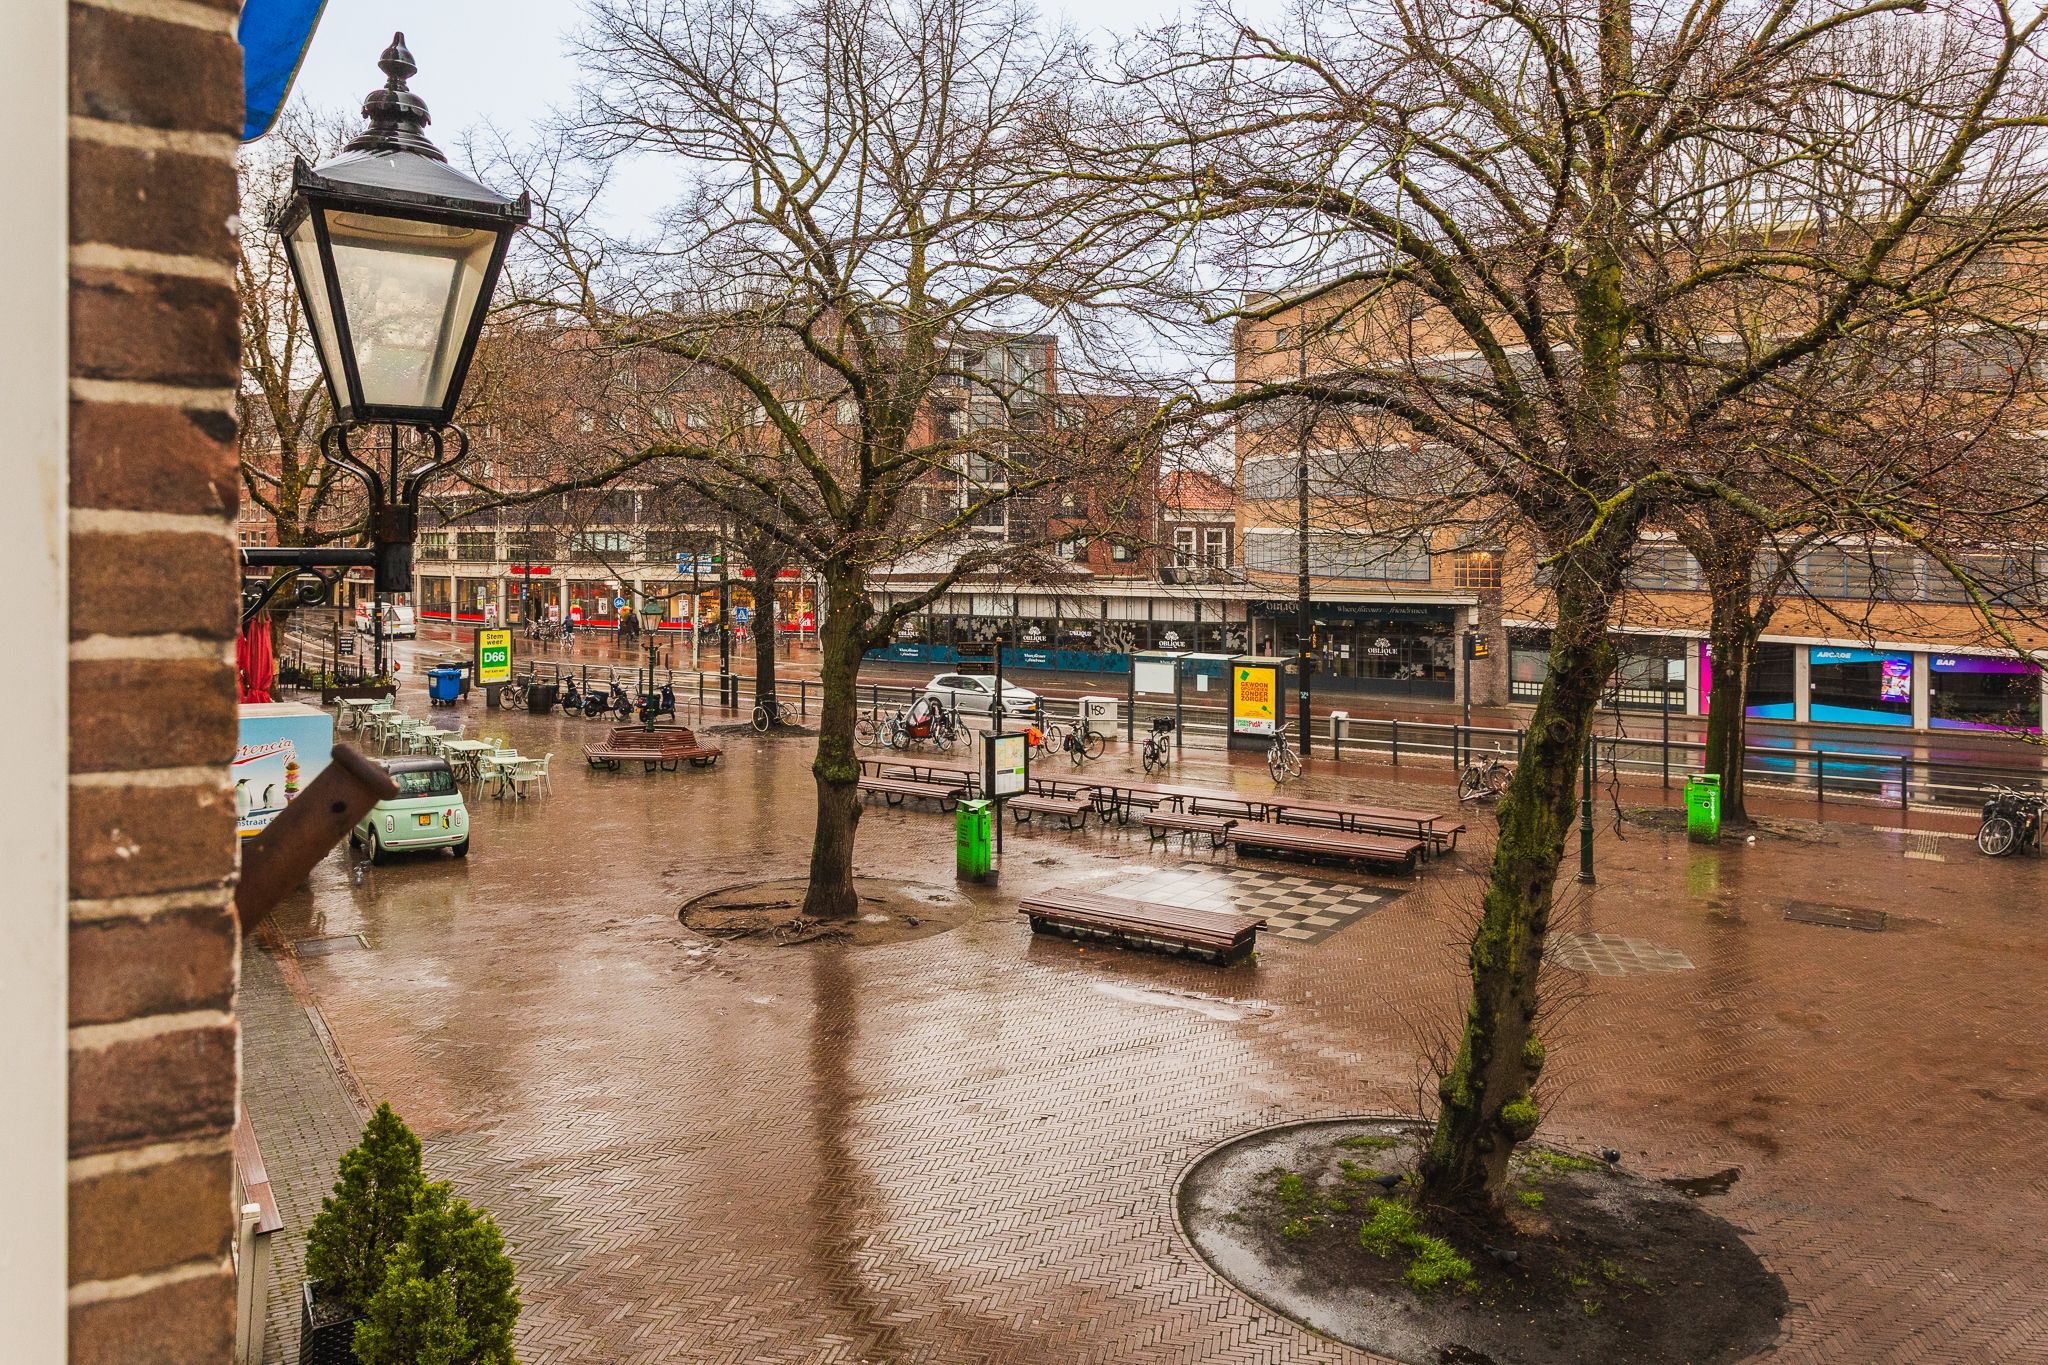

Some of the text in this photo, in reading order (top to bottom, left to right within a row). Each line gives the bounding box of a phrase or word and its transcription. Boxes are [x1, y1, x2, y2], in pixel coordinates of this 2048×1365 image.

[1158, 640, 1186, 649] OBLIQUE
[1367, 647, 1398, 656] OBLIQUE
[484, 651, 505, 663] D66
[237, 738, 292, 756] rencia
[237, 818, 267, 827] nstraat
